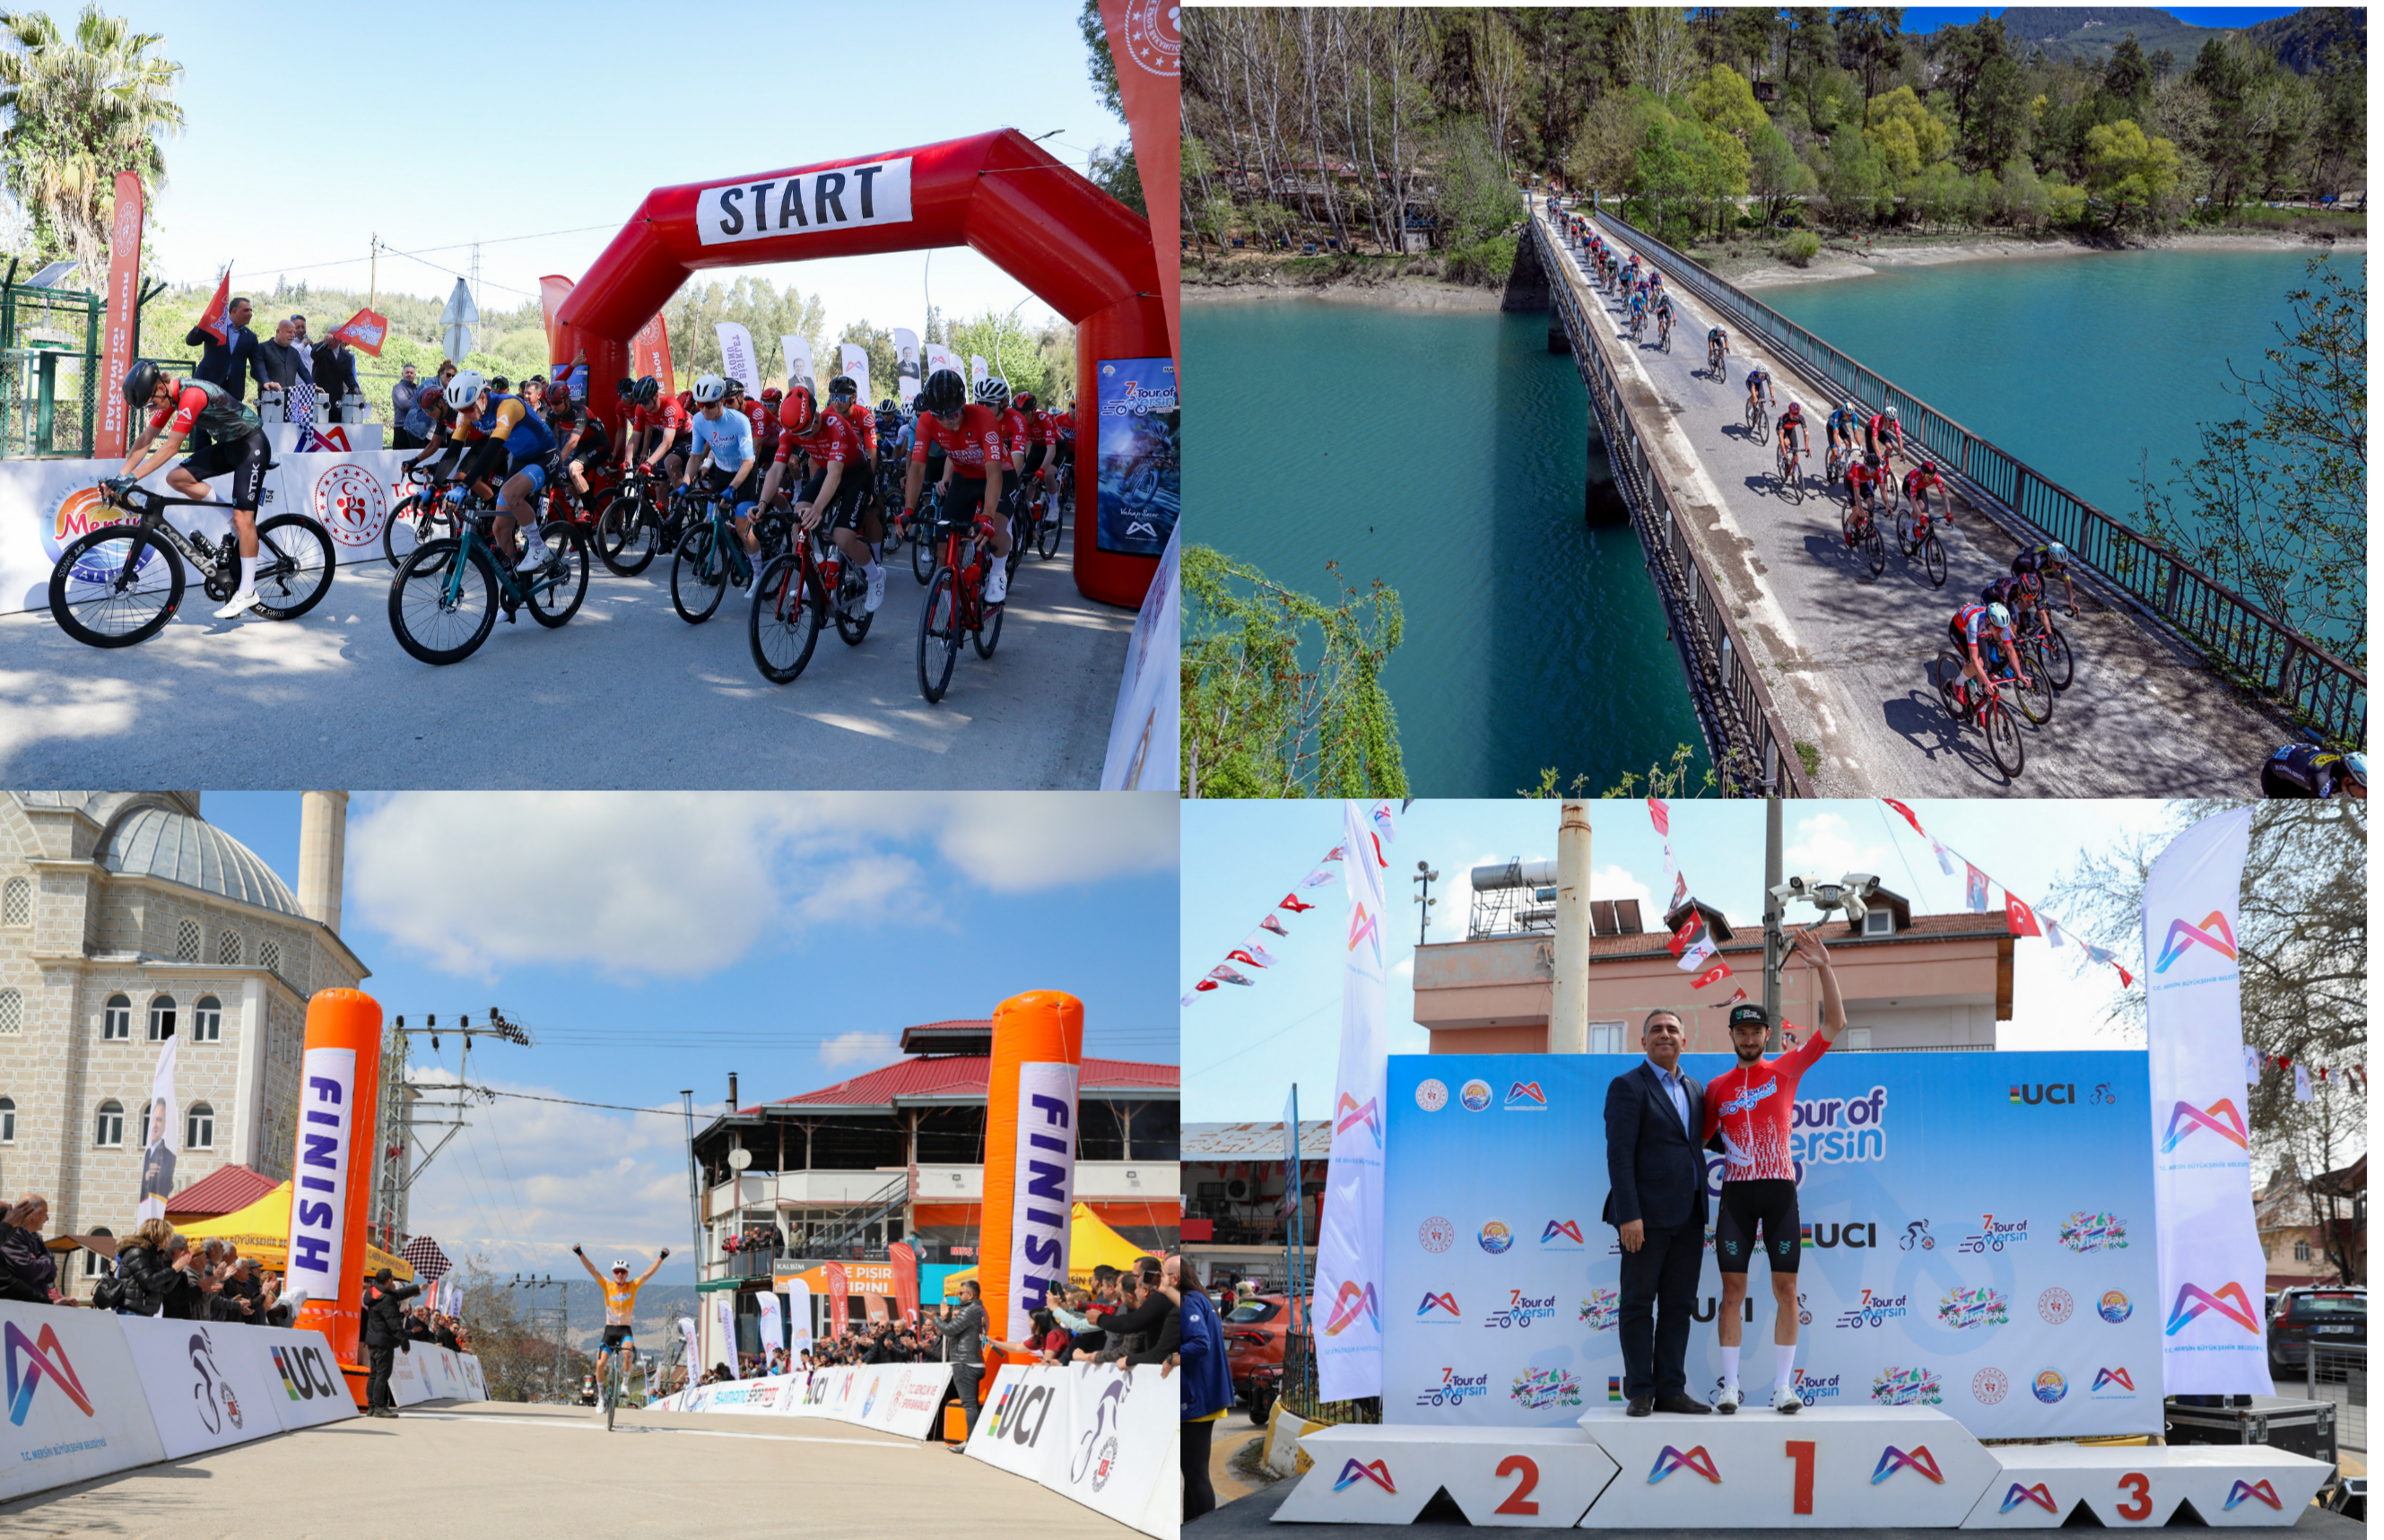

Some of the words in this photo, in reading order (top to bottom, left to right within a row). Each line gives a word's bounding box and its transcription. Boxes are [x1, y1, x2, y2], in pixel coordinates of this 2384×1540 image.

[719, 165, 883, 235] START
[1125, 381, 1137, 396] 7.
[1136, 388, 1161, 398] Tour
[1162, 387, 1175, 397] of
[990, 445, 1001, 460] ere
[248, 463, 260, 493] TDK
[46, 482, 79, 520] TÜRKİYE
[265, 490, 274, 503] 154
[57, 553, 74, 578] SWISS
[255, 605, 267, 613] DT
[265, 608, 286, 619] SWISS
[2182, 976, 2217, 987] BÜYÜKŞEHİR
[2022, 1083, 2075, 1105] UCI
[1793, 1101, 1841, 1128] our
[1848, 1089, 1884, 1126] of
[1792, 1128, 1883, 1162] ersin
[2188, 1161, 2226, 1170] BÜYÜKŞEHİR
[295, 1076, 342, 1274] FINISH
[1022, 1093, 1069, 1310] FINISH
[1982, 1214, 1994, 1230] 7.
[1993, 1222, 2015, 1233] Tour
[2016, 1219, 2028, 1231] of
[1814, 1222, 1876, 1249] UCI
[776, 1263, 805, 1271] KALBİM
[821, 1266, 853, 1278] PE
[1510, 1290, 1521, 1305] 7.
[1520, 1297, 1544, 1309] Tour
[1544, 1295, 1556, 1308] of
[1861, 1289, 1873, 1305] 7.
[1871, 1297, 1893, 1308] Tour
[1895, 1294, 1907, 1307] of
[1692, 1297, 1753, 1323] UI
[2197, 1343, 2235, 1352] BÜYÜKŞEHİR
[288, 1346, 337, 1400] UCI
[1442, 1367, 1453, 1383] 7.
[1452, 1375, 1475, 1387] Tour
[1476, 1373, 1488, 1386] of
[1794, 1369, 1805, 1385] 7.
[1804, 1377, 1826, 1388] Tour
[1828, 1374, 1840, 1387] of
[715, 1390, 749, 1405] SHIMANO
[808, 1377, 829, 1405] UCI
[996, 1384, 1056, 1449] UCI
[21, 1451, 33, 1462] T.C.
[31, 1445, 53, 1459] MERSİN
[53, 1440, 84, 1456] BÜYÜKŞEHİR
[83, 1435, 108, 1450] BELEDİYESİ
[1494, 1454, 1539, 1515] 2
[1786, 1440, 1815, 1514] 1
[2117, 1472, 2153, 1520] 3
